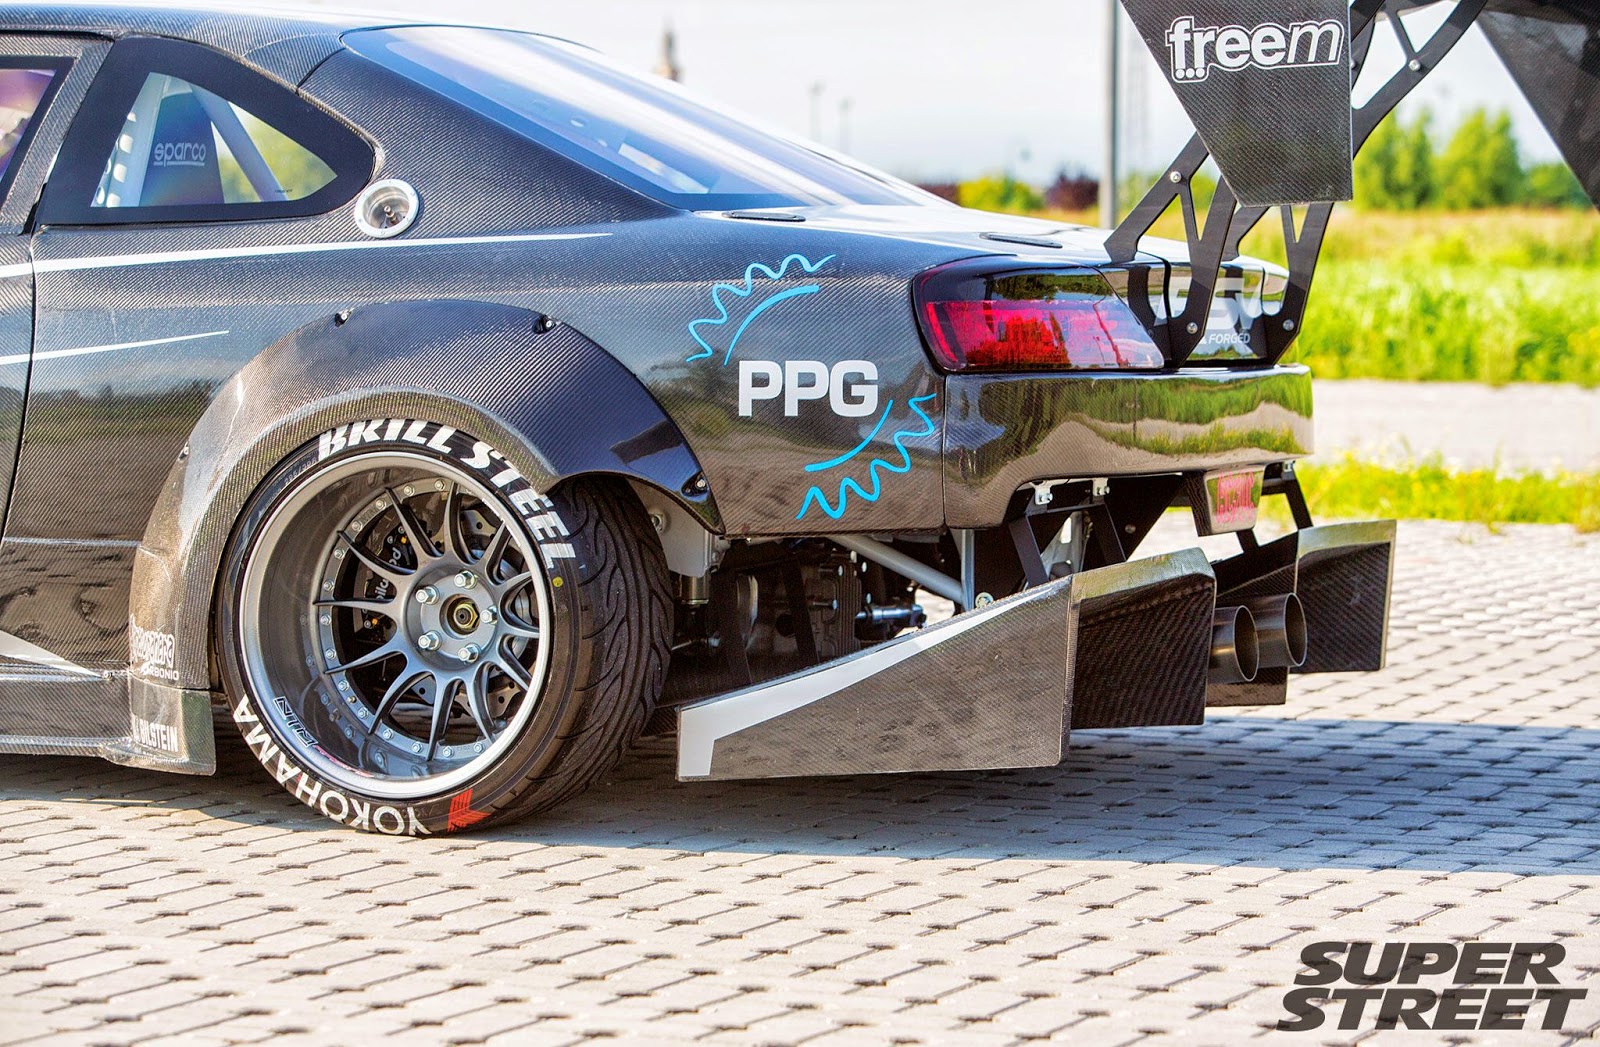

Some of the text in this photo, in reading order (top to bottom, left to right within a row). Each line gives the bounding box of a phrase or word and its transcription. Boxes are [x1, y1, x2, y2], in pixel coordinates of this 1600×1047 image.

[1168, 18, 1343, 80] freem
[153, 141, 207, 167] sparco
[1208, 333, 1250, 345] FORGED
[738, 360, 879, 417] PPG
[318, 418, 576, 569] BRILL STEEL
[232, 696, 432, 836] YOKOHAMA
